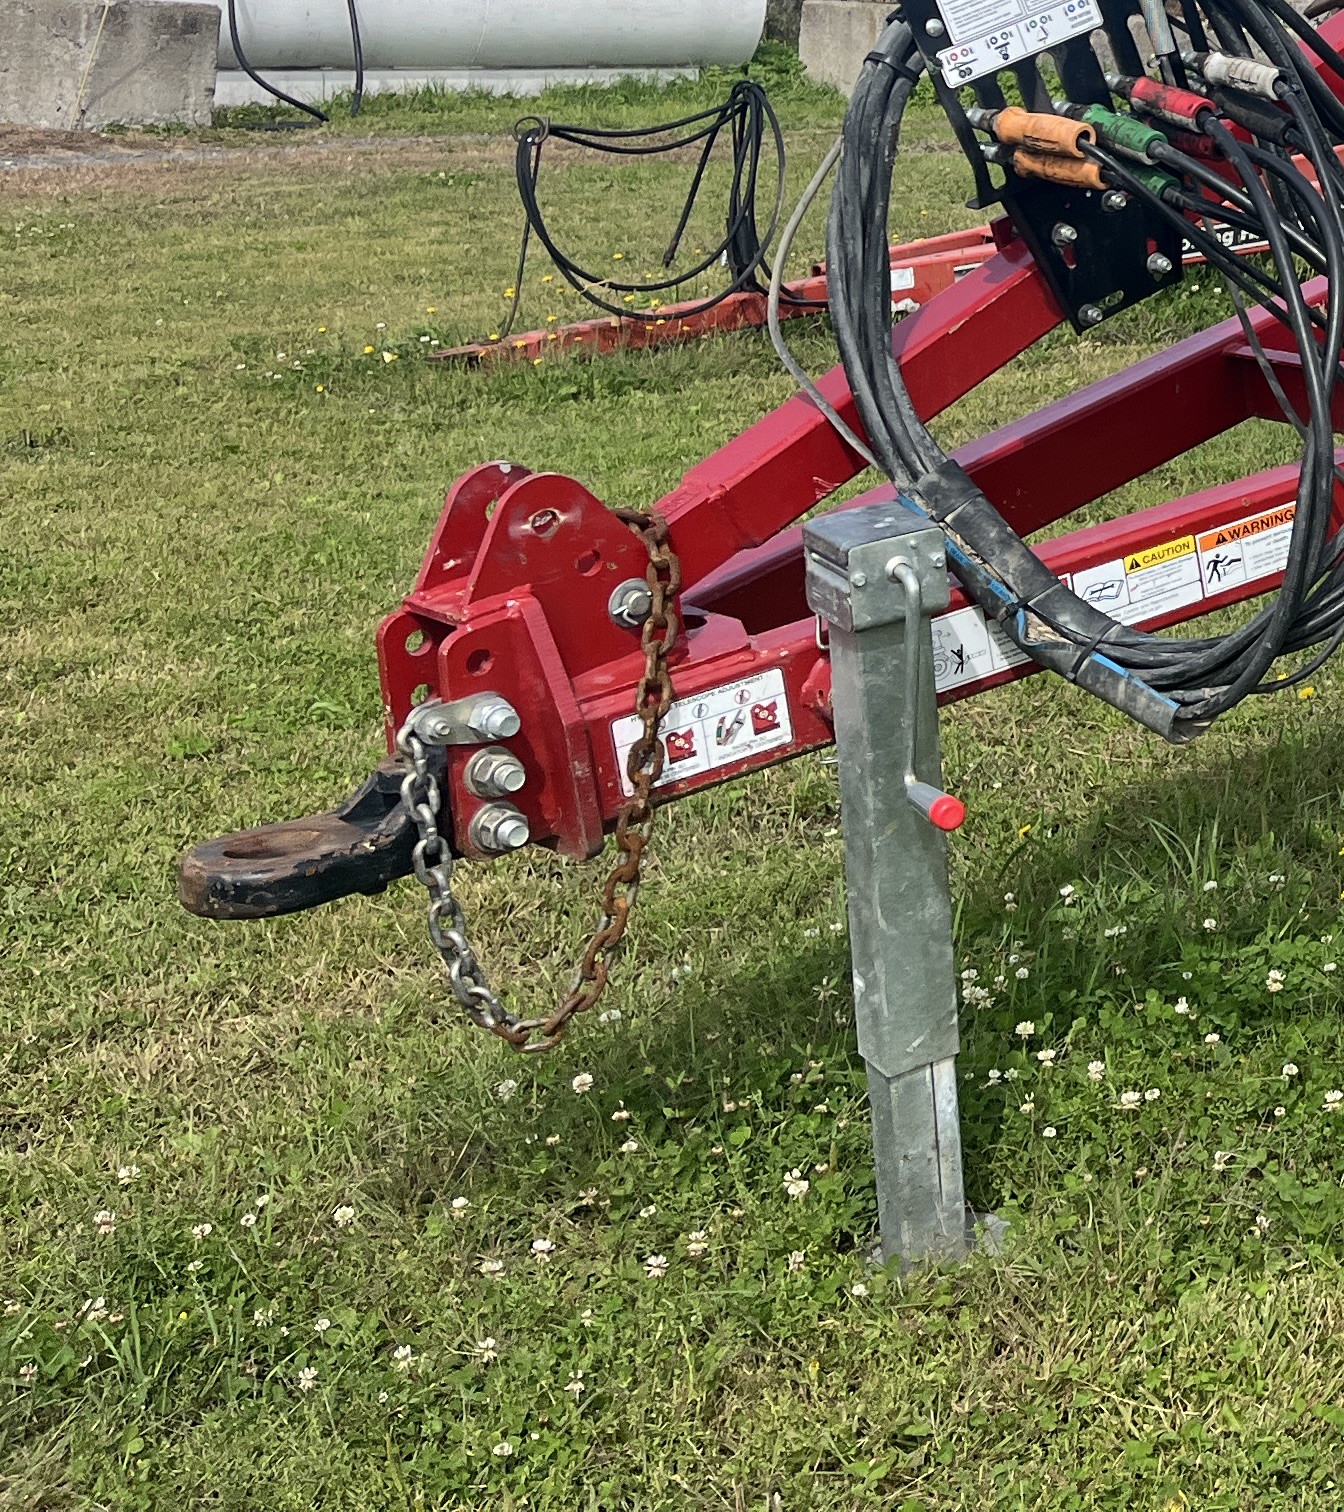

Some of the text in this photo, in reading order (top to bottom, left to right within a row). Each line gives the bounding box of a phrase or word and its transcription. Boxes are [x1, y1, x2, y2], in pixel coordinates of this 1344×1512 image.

[1227, 509, 1295, 541] WARNING
[1141, 541, 1191, 565] CAUTION
[674, 691, 716, 708] TELESCOPE
